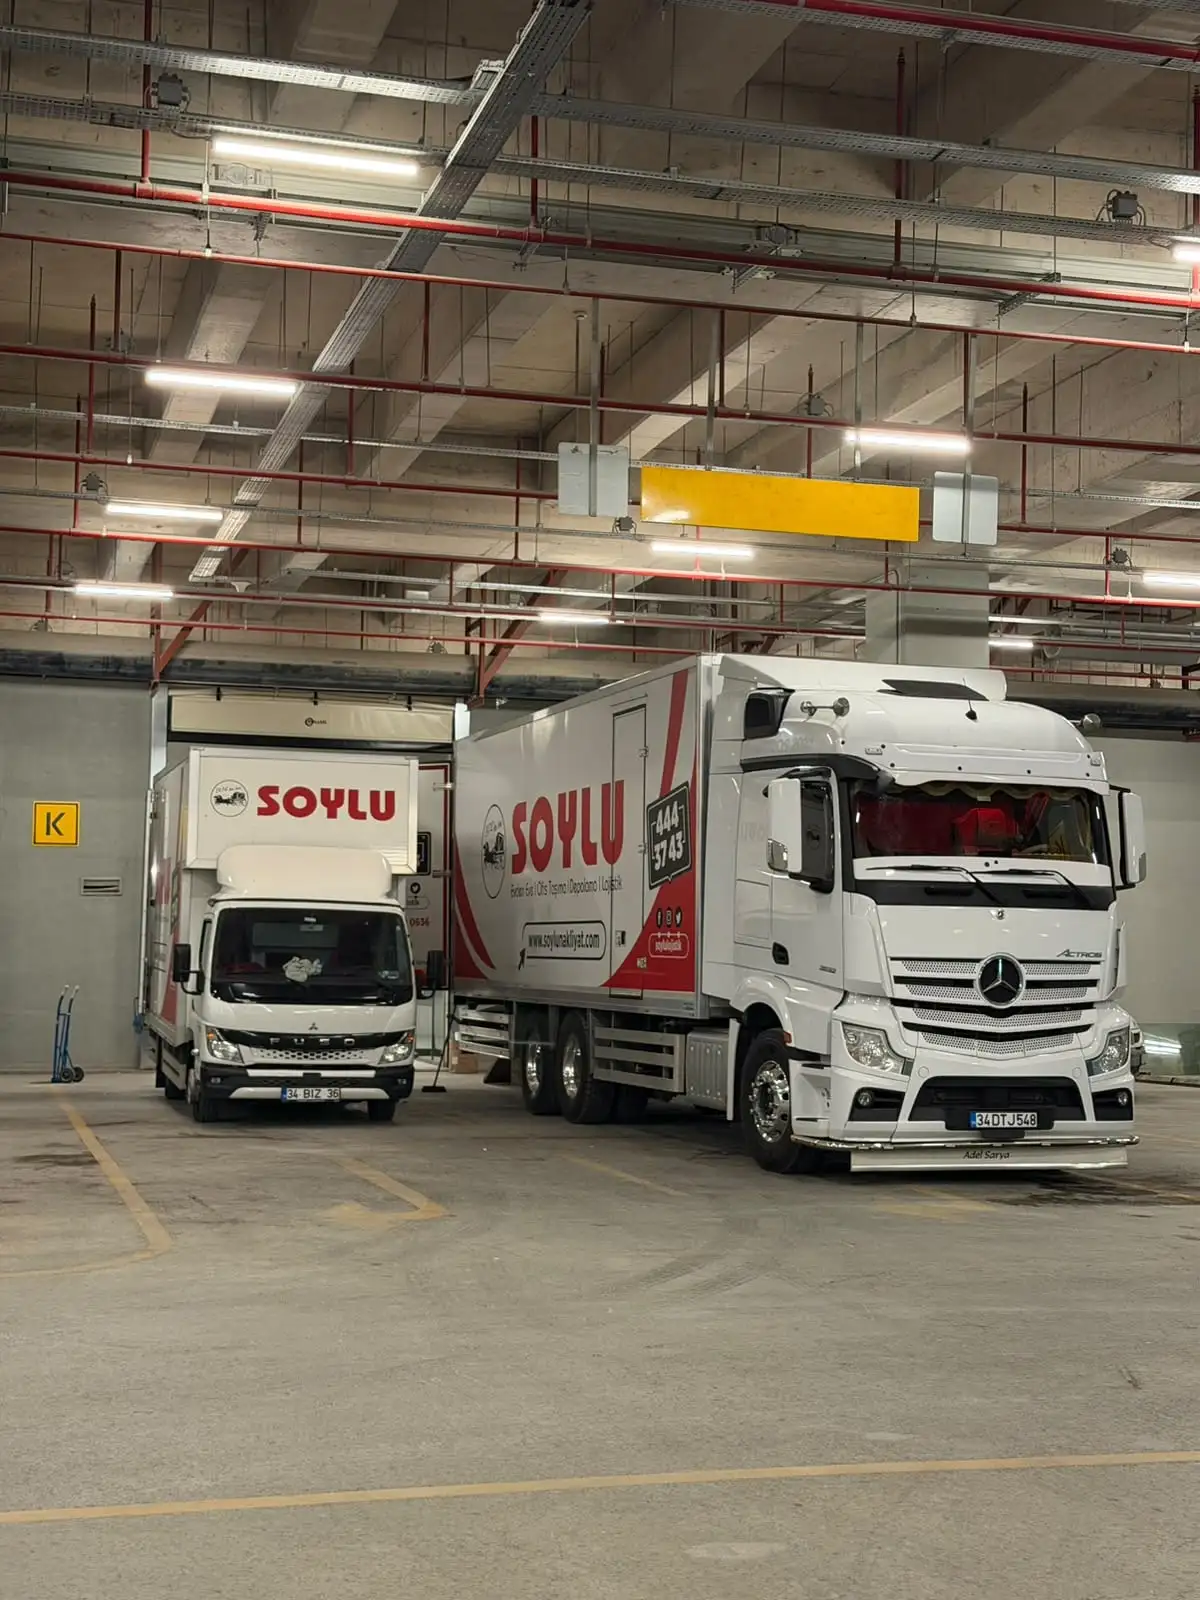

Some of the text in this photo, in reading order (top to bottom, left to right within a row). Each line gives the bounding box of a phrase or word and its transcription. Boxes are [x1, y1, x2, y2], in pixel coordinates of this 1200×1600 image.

[257, 785, 396, 821] SOYLU
[45, 811, 66, 836] K
[511, 779, 624, 875] SOYLU
[655, 800, 680, 836] 444
[269, 1037, 355, 1046] FUSO
[287, 1088, 339, 1099] 34 BIZ 36
[963, 1151, 982, 1159] Adel
